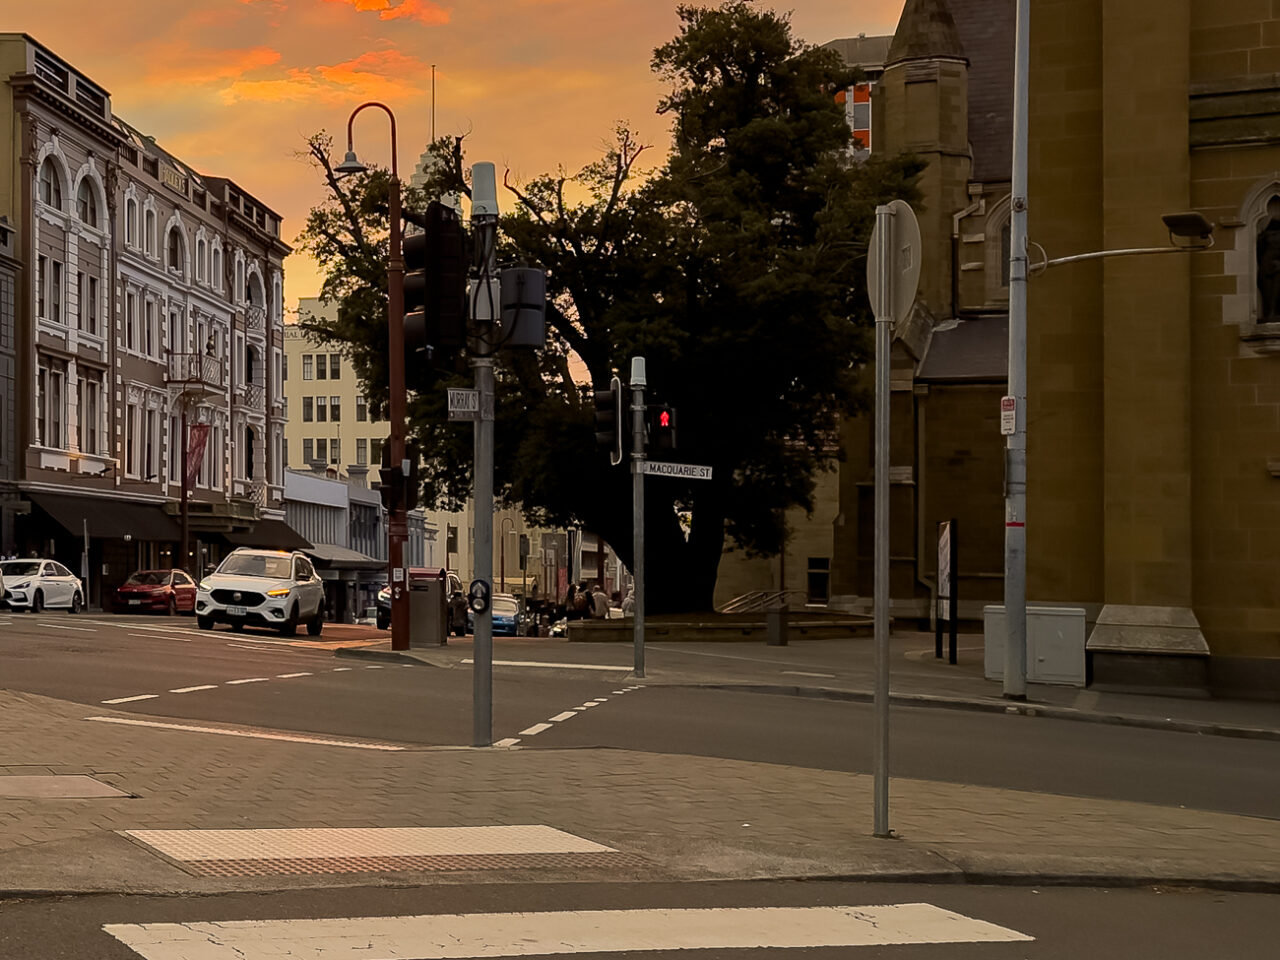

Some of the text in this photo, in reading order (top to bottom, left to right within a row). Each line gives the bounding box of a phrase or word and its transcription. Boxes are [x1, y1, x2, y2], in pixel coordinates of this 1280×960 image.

[449, 391, 470, 410] MURRAY
[649, 463, 710, 478] MACQUARIE ST
